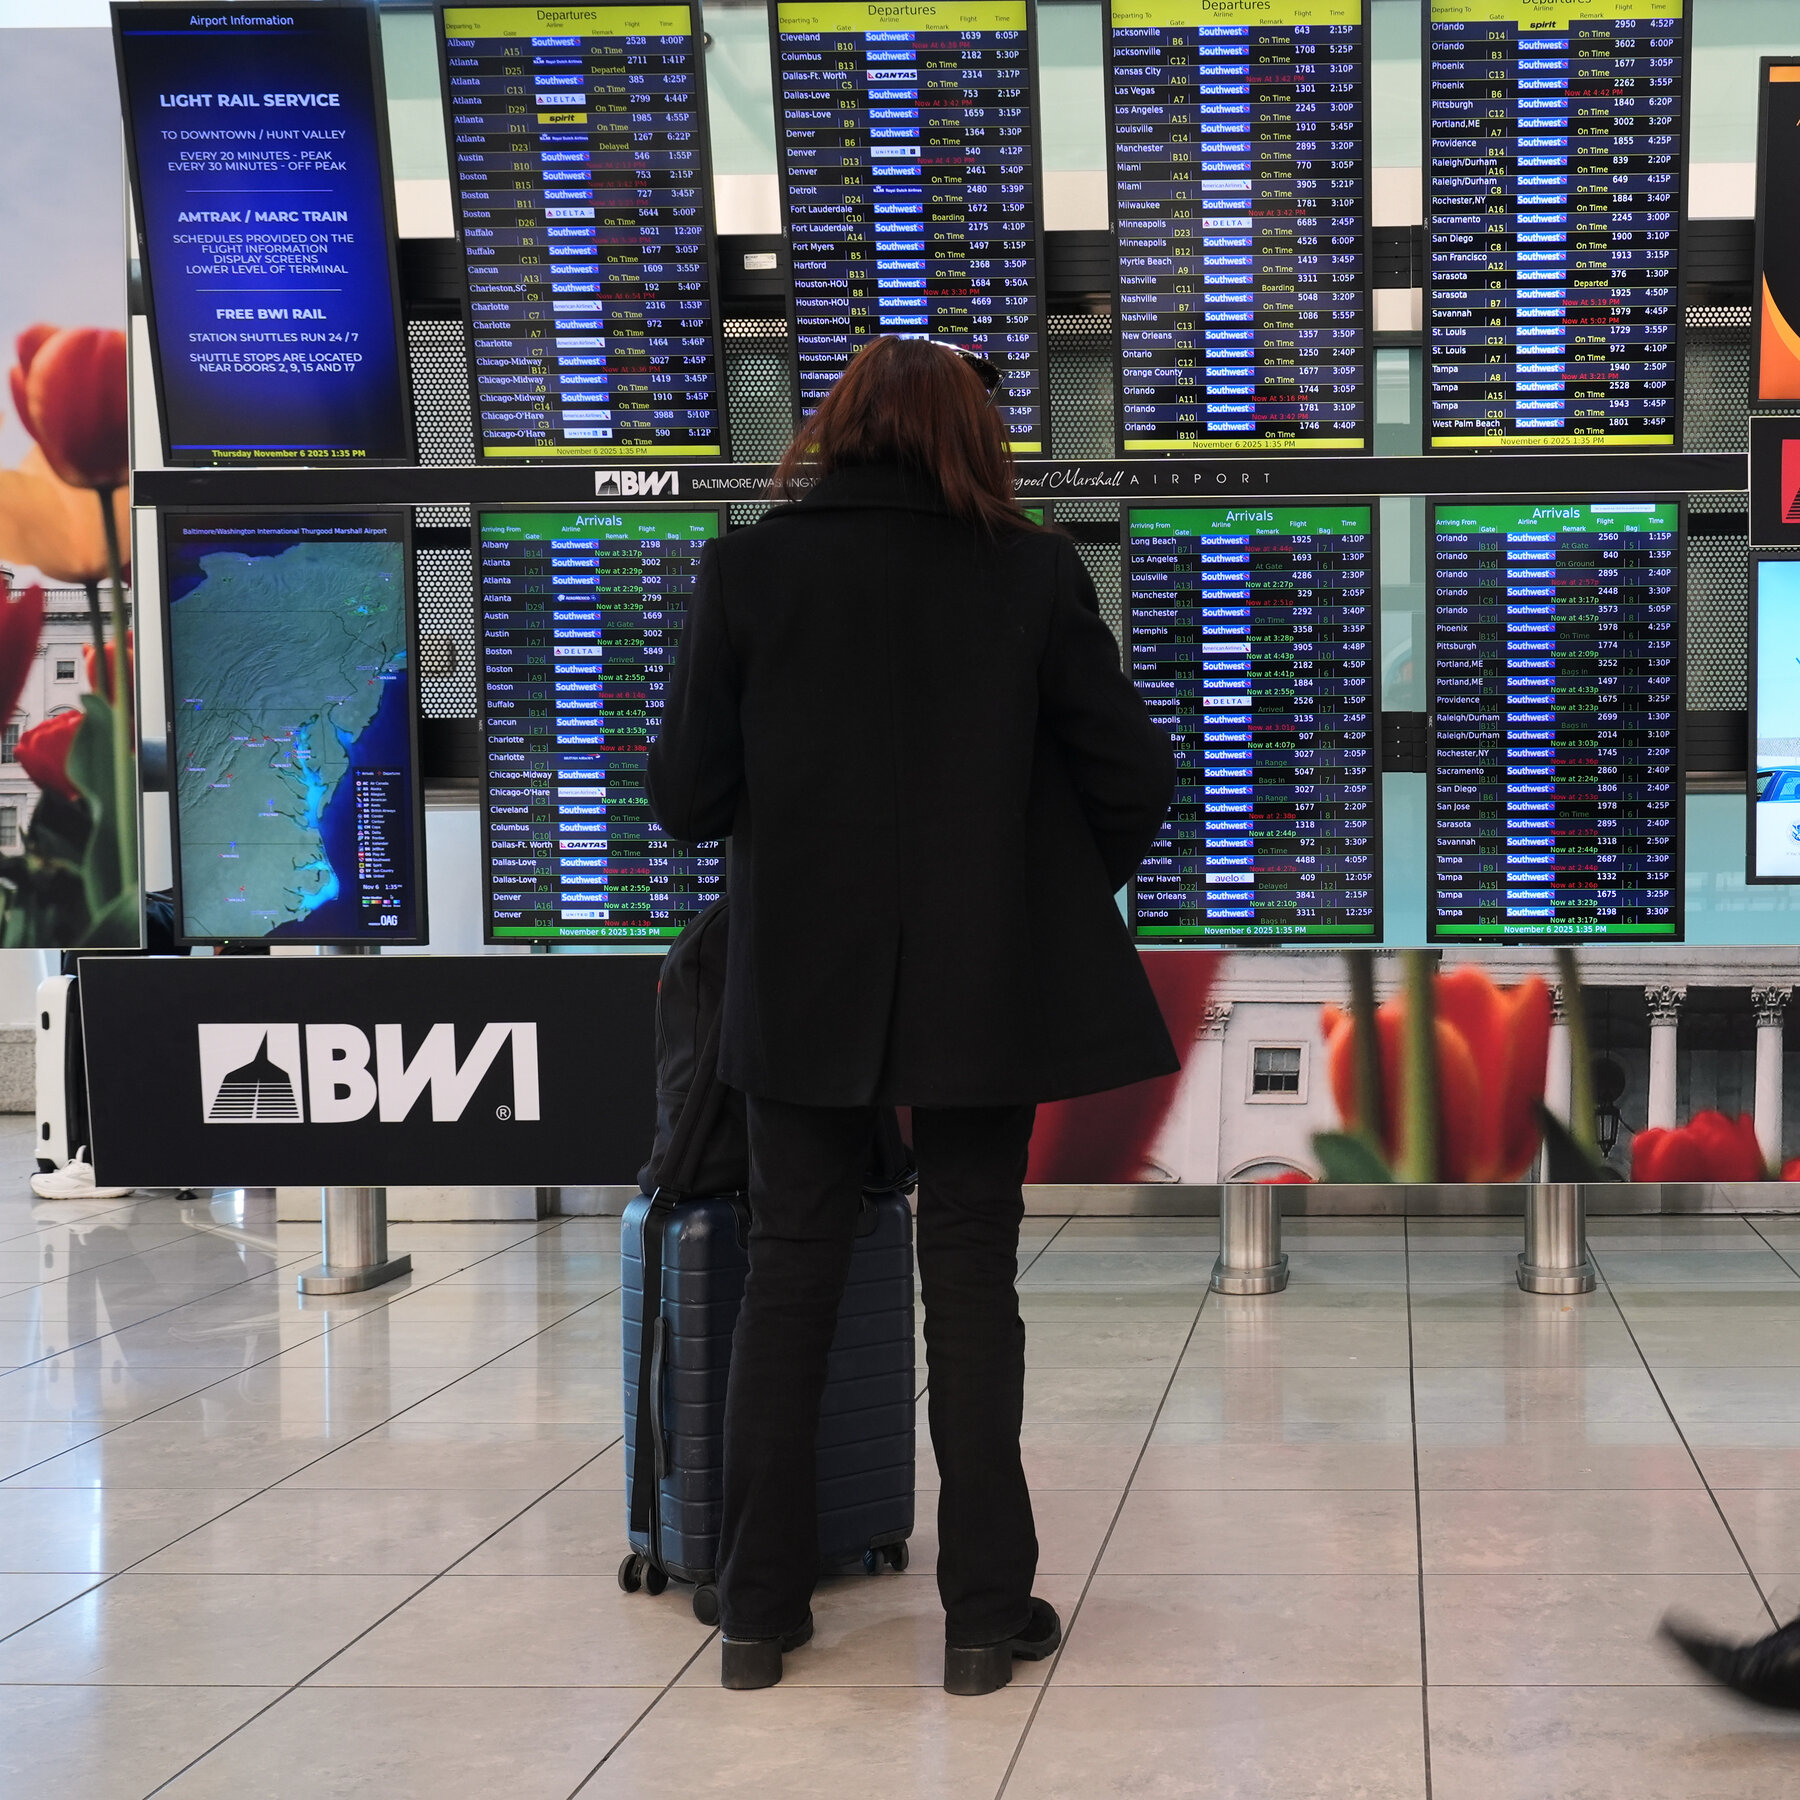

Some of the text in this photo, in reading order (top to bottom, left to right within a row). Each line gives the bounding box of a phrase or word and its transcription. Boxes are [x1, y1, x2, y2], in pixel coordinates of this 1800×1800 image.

[1202, 0, 1270, 10] Departures
[537, 10, 597, 21] Departures
[868, 5, 936, 17] Departures
[189, 15, 294, 27] Airport Information
[1432, 20, 1674, 30] Orlando spirit 2950 4:52P
[1113, 26, 1352, 37] Jacksonville Southwest 643 2:15P
[447, 37, 684, 48] Albany Southwest 2528 4:00P
[504, 48, 520, 56] A15
[782, 51, 1019, 61] Columbus Southwest 2182 5:30P
[783, 72, 821, 80] Dallas-Ft.
[824, 71, 847, 80] Worth
[997, 70, 1020, 78] 3:17P
[160, 93, 340, 107] LIGHT RAIL SERVICE
[1132, 106, 1163, 115] Angeles
[1330, 104, 1353, 112] 3:00P
[454, 116, 484, 124] Atlanta
[550, 114, 574, 123] spirit
[666, 113, 689, 121] 4:55P
[1432, 120, 1480, 128] Portland,ME
[1518, 119, 1560, 127] Southwest
[1648, 117, 1671, 125] 3:20P
[161, 130, 346, 139] TO DOWNTOWN HUNT VALLEY
[1117, 144, 1163, 152] Manchester
[180, 151, 332, 160] EVERY 20 MINUTES PEAK
[168, 162, 346, 171] EVERY 30 MINUTES OFF PEAK
[178, 210, 347, 223] AMTRAK MARC TRAIN
[1119, 220, 1166, 229] Minneapolis
[173, 234, 354, 244] SCHEDULES PROVIDED ON THE
[202, 245, 328, 254] FLIGHT INFORMATION
[214, 255, 318, 264] DISPLAY SCREENS
[186, 265, 348, 274] LOWER LEVEL OF TERMINAL
[1574, 279, 1608, 287] Departed
[470, 284, 527, 293] Charleston,SC
[796, 297, 1028, 306] Houston-HOU 4669 5:10P
[216, 309, 326, 319] FREE BWI RAIL
[189, 333, 358, 342] STATION SHUTTLES RUN 24 7
[190, 353, 362, 363] SHUTTLE STOPS ARE LOCATED
[199, 363, 355, 374] NEAR DOORS 2, 9, 15 AND 17
[1123, 368, 1182, 378] Orange County
[481, 411, 544, 420] Chicago-O'Hare
[212, 449, 366, 458] Thursday November 6 2025 1:35 PM
[622, 471, 679, 495] BWI
[1049, 468, 1124, 488] Marshall
[1226, 510, 1273, 521] Arrivals
[1533, 508, 1580, 518] Arrivals
[576, 515, 622, 526] Arrivals
[364, 527, 387, 535] Airport
[482, 541, 509, 550] Albany
[552, 541, 593, 549] Southwest
[622, 550, 642, 558] 3:17p
[1133, 627, 1167, 636] Memphis
[1203, 626, 1244, 634] Southwest
[1343, 625, 1365, 633] 3:35P
[1507, 696, 1549, 704] Southwest
[1215, 874, 1239, 882] avelo
[1345, 873, 1372, 881] 12:05P
[381, 915, 397, 925] OAG
[306, 1022, 540, 1123] BWI
